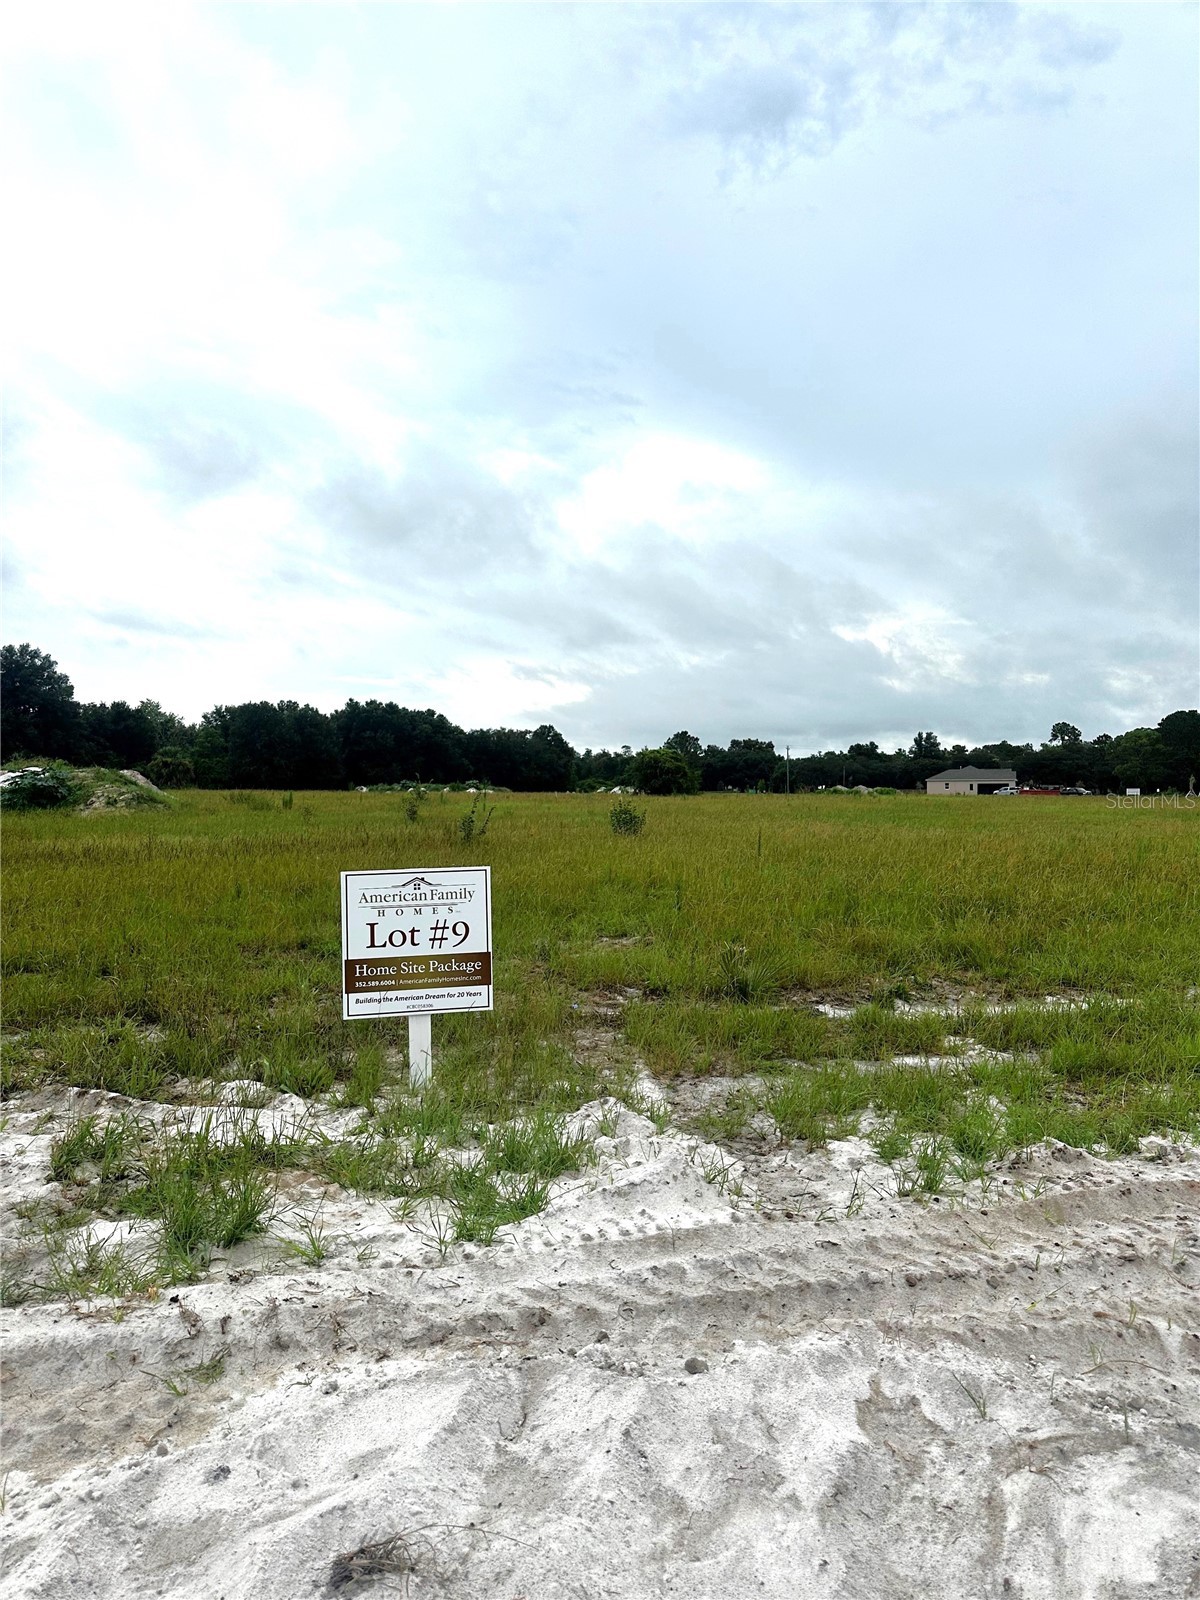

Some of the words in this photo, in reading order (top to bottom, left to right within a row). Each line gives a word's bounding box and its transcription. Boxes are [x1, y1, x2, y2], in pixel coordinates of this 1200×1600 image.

[359, 891, 427, 904] American
[430, 888, 476, 902] Family
[377, 906, 454, 917] HOMES
[366, 922, 420, 949] Lot
[429, 919, 470, 949] #9
[355, 964, 397, 977] Home
[400, 962, 426, 974] Site
[429, 959, 482, 973] Package
[399, 975, 481, 985] AmericanFamilyHomesInc.com
